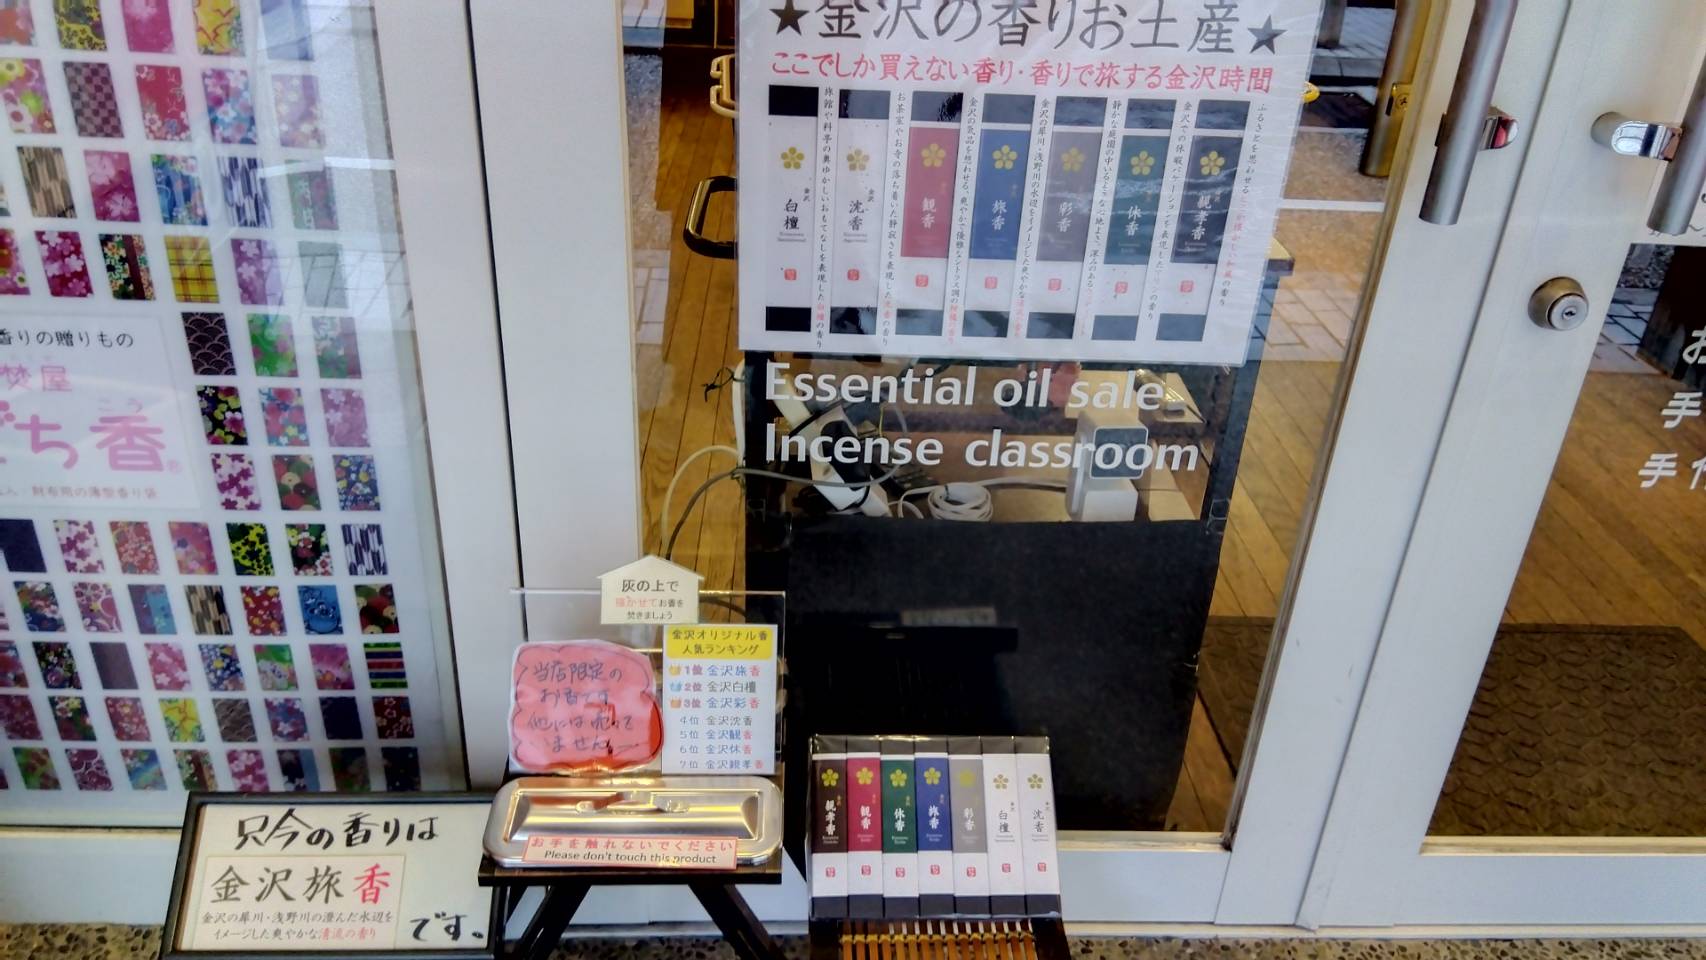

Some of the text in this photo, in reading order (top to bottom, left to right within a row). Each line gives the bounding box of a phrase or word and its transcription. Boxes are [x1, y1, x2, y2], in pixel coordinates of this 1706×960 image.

[816, 0, 1240, 53] 金沢の香りお土産
[771, 51, 1274, 94] ここでしか買えない香り・香りで旅する金沢時間
[783, 198, 801, 230] 白檀
[848, 199, 865, 232] 沈香
[765, 359, 1164, 411] Essential oil sale
[765, 422, 1199, 471] Incense classroom
[621, 578, 680, 593] 灰の上で
[671, 628, 768, 641] 金沢オリジナル香
[682, 643, 760, 656] 人気ランキング
[707, 680, 757, 694] 金沢白檀
[679, 729, 699, 740] 5位
[679, 744, 699, 755] 6位
[234, 807, 439, 850] 只今の香りは
[999, 809, 1010, 834] 白檀
[1032, 808, 1045, 833] 沈香
[530, 836, 733, 852] お手を触れないでください
[544, 850, 717, 866] Please don't touch this product
[210, 863, 391, 905] 金沢旅香
[409, 912, 485, 943] です。
